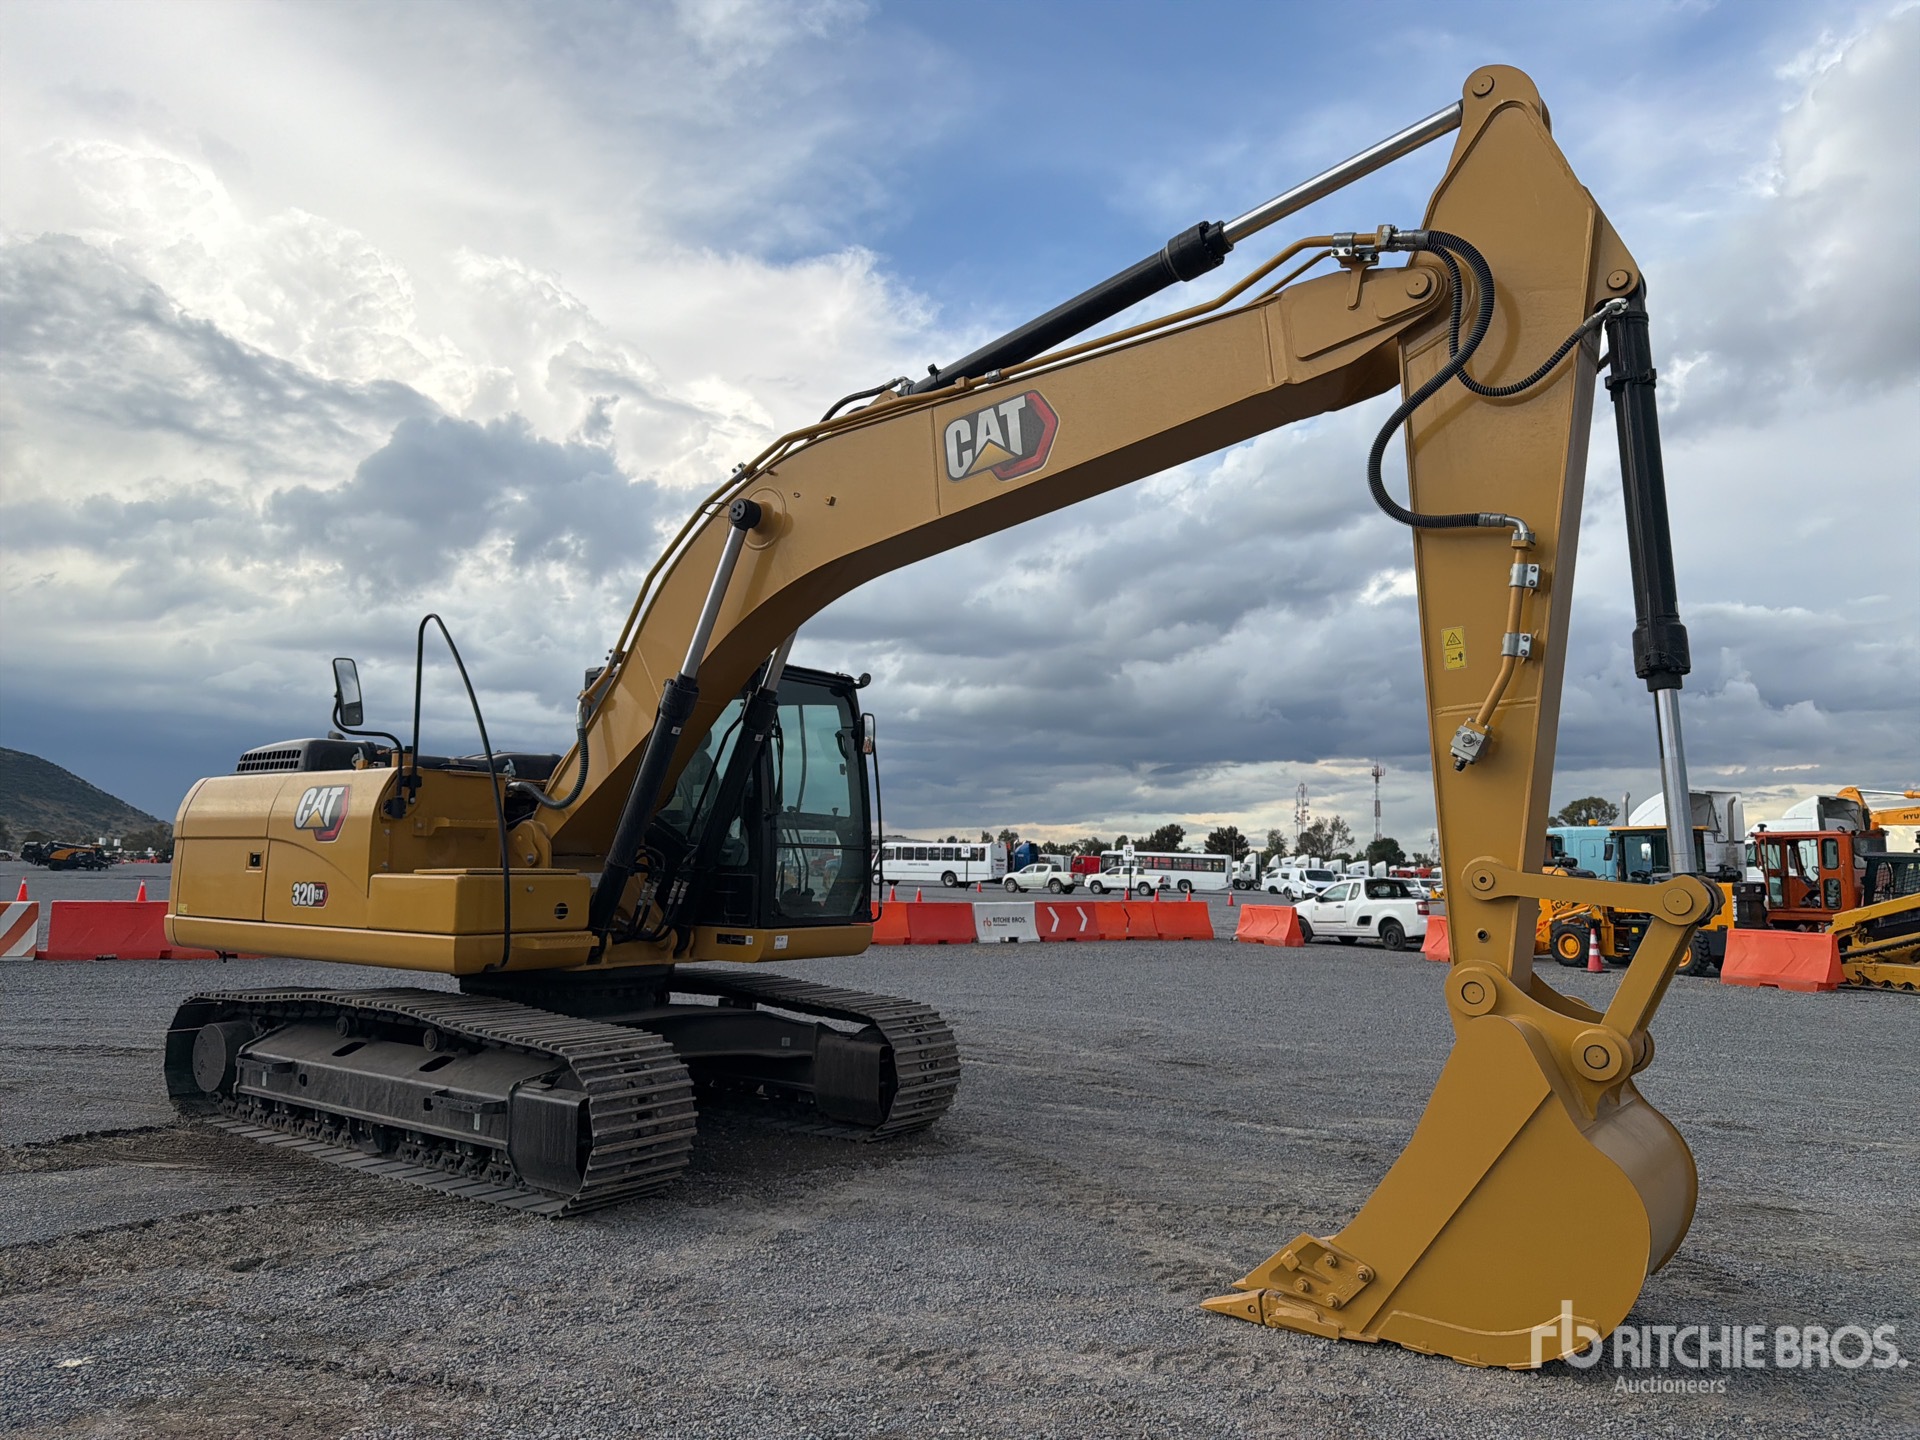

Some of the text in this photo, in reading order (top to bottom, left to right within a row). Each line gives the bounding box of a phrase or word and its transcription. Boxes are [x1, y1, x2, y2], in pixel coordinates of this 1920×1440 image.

[945, 395, 1026, 479] CAT
[295, 786, 345, 829] CAT
[1125, 849, 1133, 858] 15
